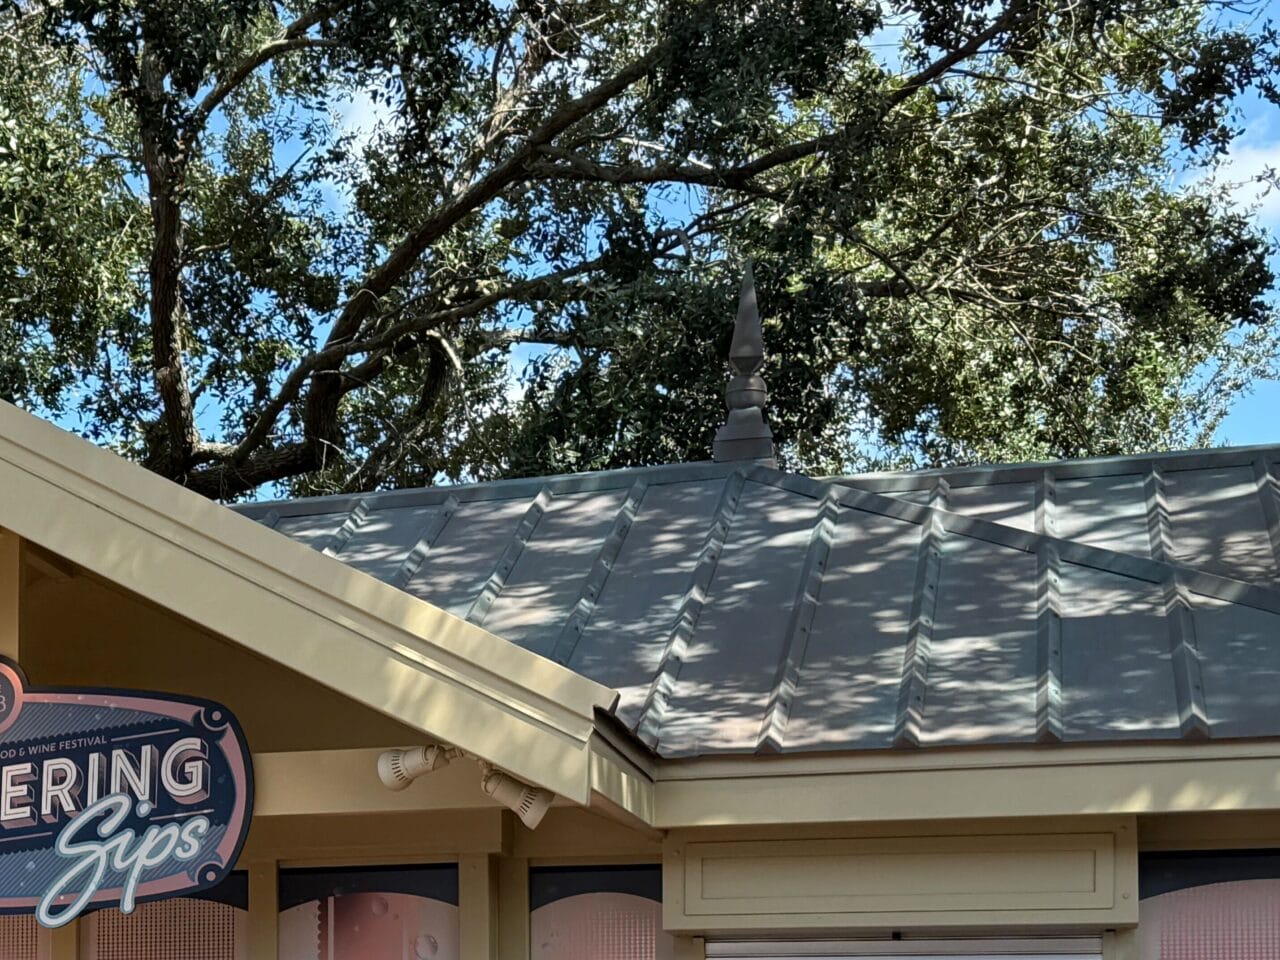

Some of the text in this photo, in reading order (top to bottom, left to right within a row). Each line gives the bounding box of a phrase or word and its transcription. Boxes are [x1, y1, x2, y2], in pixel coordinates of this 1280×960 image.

[18, 747, 26, 757] &
[27, 743, 57, 756] WINE
[59, 736, 108, 752] FESTIVAL
[35, 791, 210, 928] Sips
